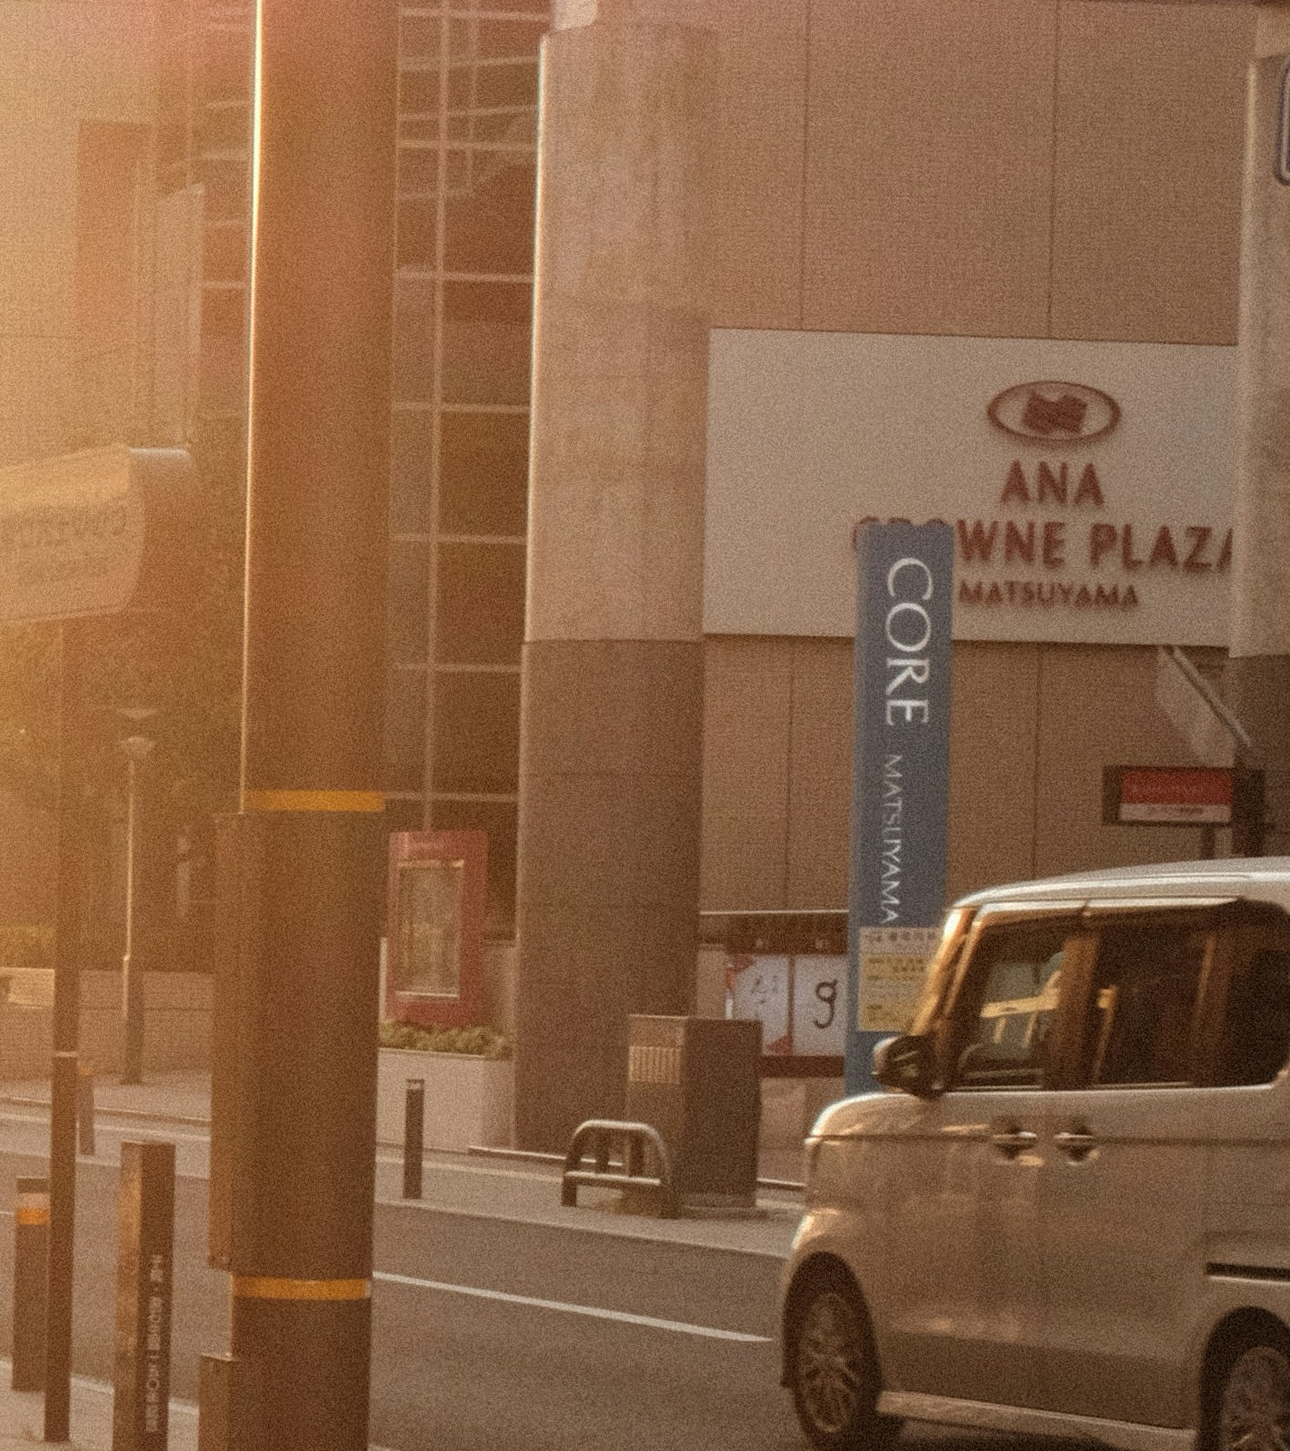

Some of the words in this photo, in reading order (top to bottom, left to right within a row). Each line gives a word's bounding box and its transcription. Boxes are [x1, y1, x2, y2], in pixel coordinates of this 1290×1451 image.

[1000, 460, 1105, 507] ANA
[885, 556, 934, 727] CORE
[957, 579, 1139, 610] MATSUYAMA
[881, 753, 903, 924] MATSUYAMA
